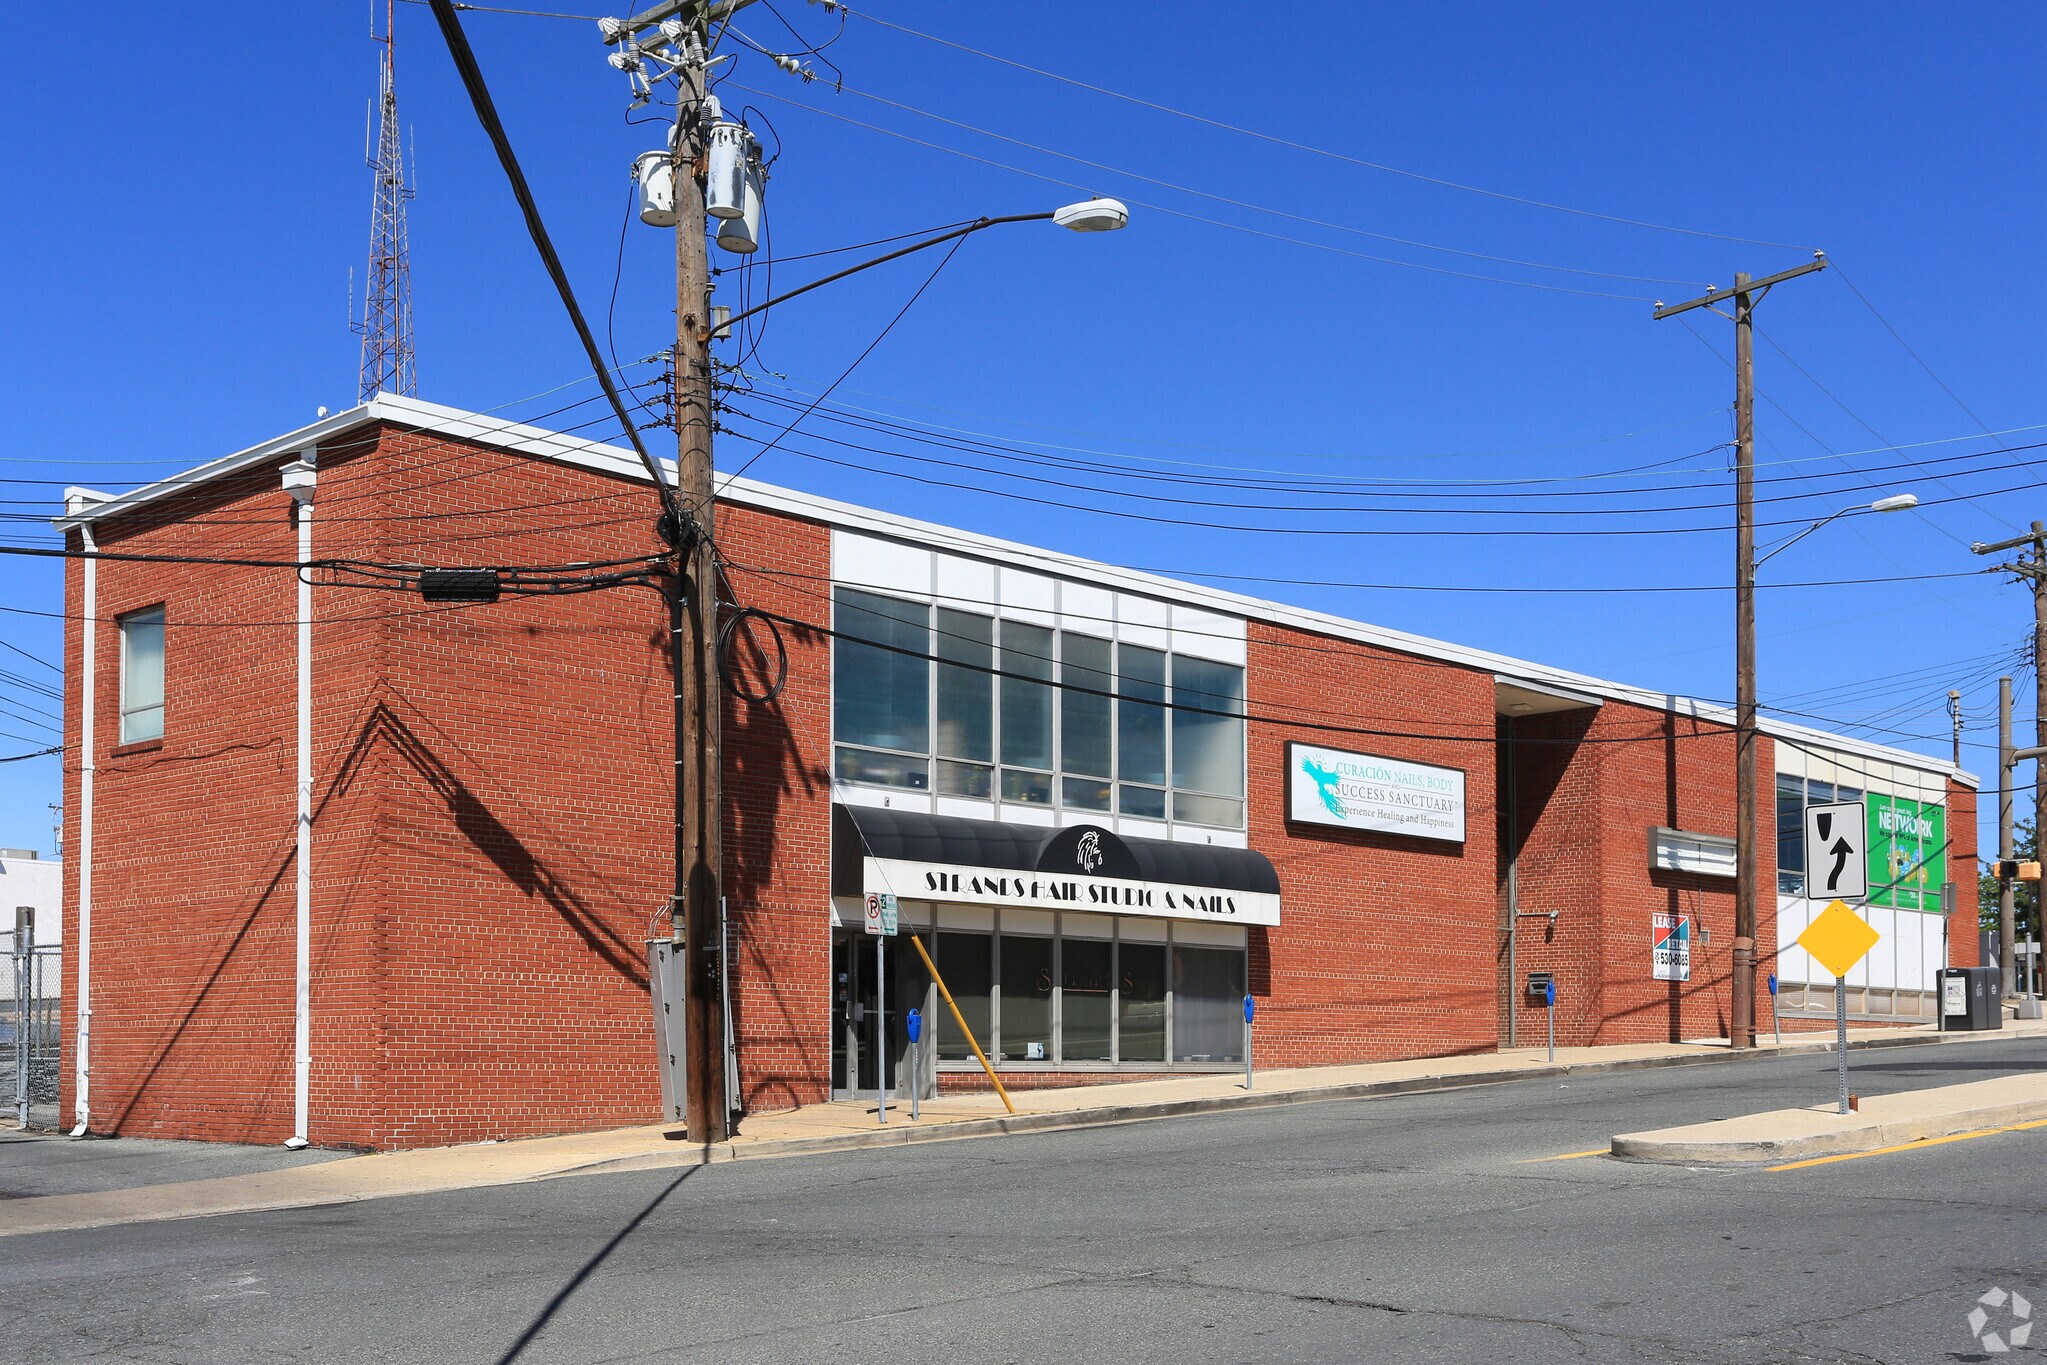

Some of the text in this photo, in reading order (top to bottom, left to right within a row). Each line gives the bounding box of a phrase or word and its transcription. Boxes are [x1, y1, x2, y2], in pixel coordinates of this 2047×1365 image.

[1336, 762, 1453, 791] CURACIÓN NAILS, BODY
[1335, 782, 1385, 801] SUCCESS
[1335, 803, 1454, 828] Experience Healing and Happiness
[1879, 811, 1933, 837] NETWORK
[925, 871, 1236, 914] STRANDS HAIR STUDIO & NAILS
[1654, 916, 1676, 928] LEASE
[1667, 938, 1688, 950] RETAIL
